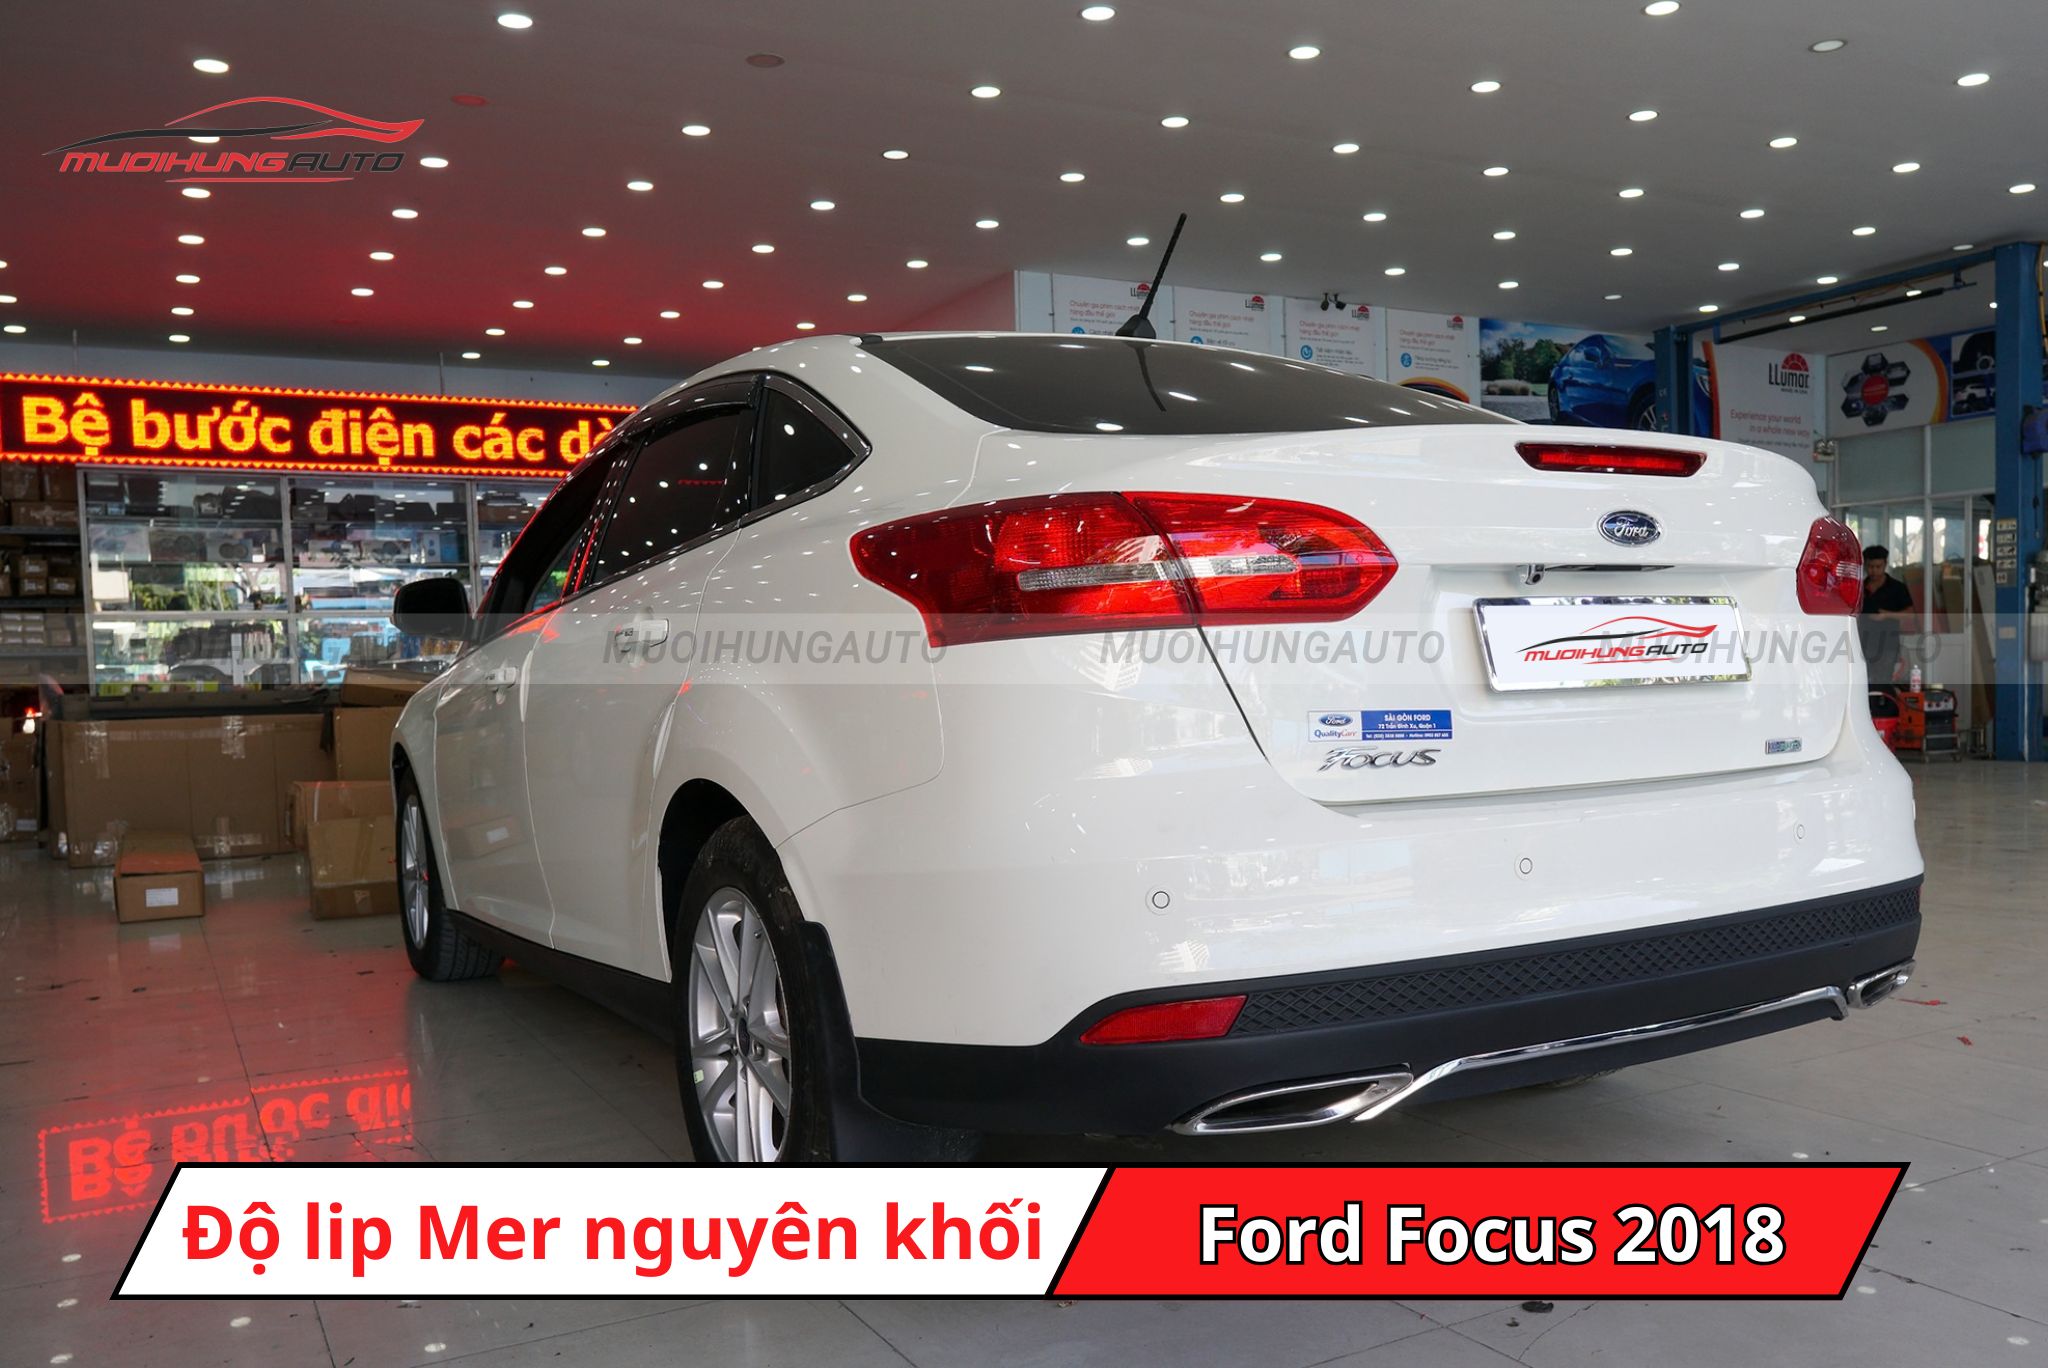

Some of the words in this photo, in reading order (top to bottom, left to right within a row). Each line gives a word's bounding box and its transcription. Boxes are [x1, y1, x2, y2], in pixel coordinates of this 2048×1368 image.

[1730, 409, 1766, 420] Experience
[22, 392, 111, 462] Bệ
[130, 399, 293, 454] bước
[308, 407, 436, 466] điện
[452, 412, 545, 463] các
[1523, 641, 1709, 663] MUOIHUNGAUTO
[1397, 712, 1412, 721] GÒN
